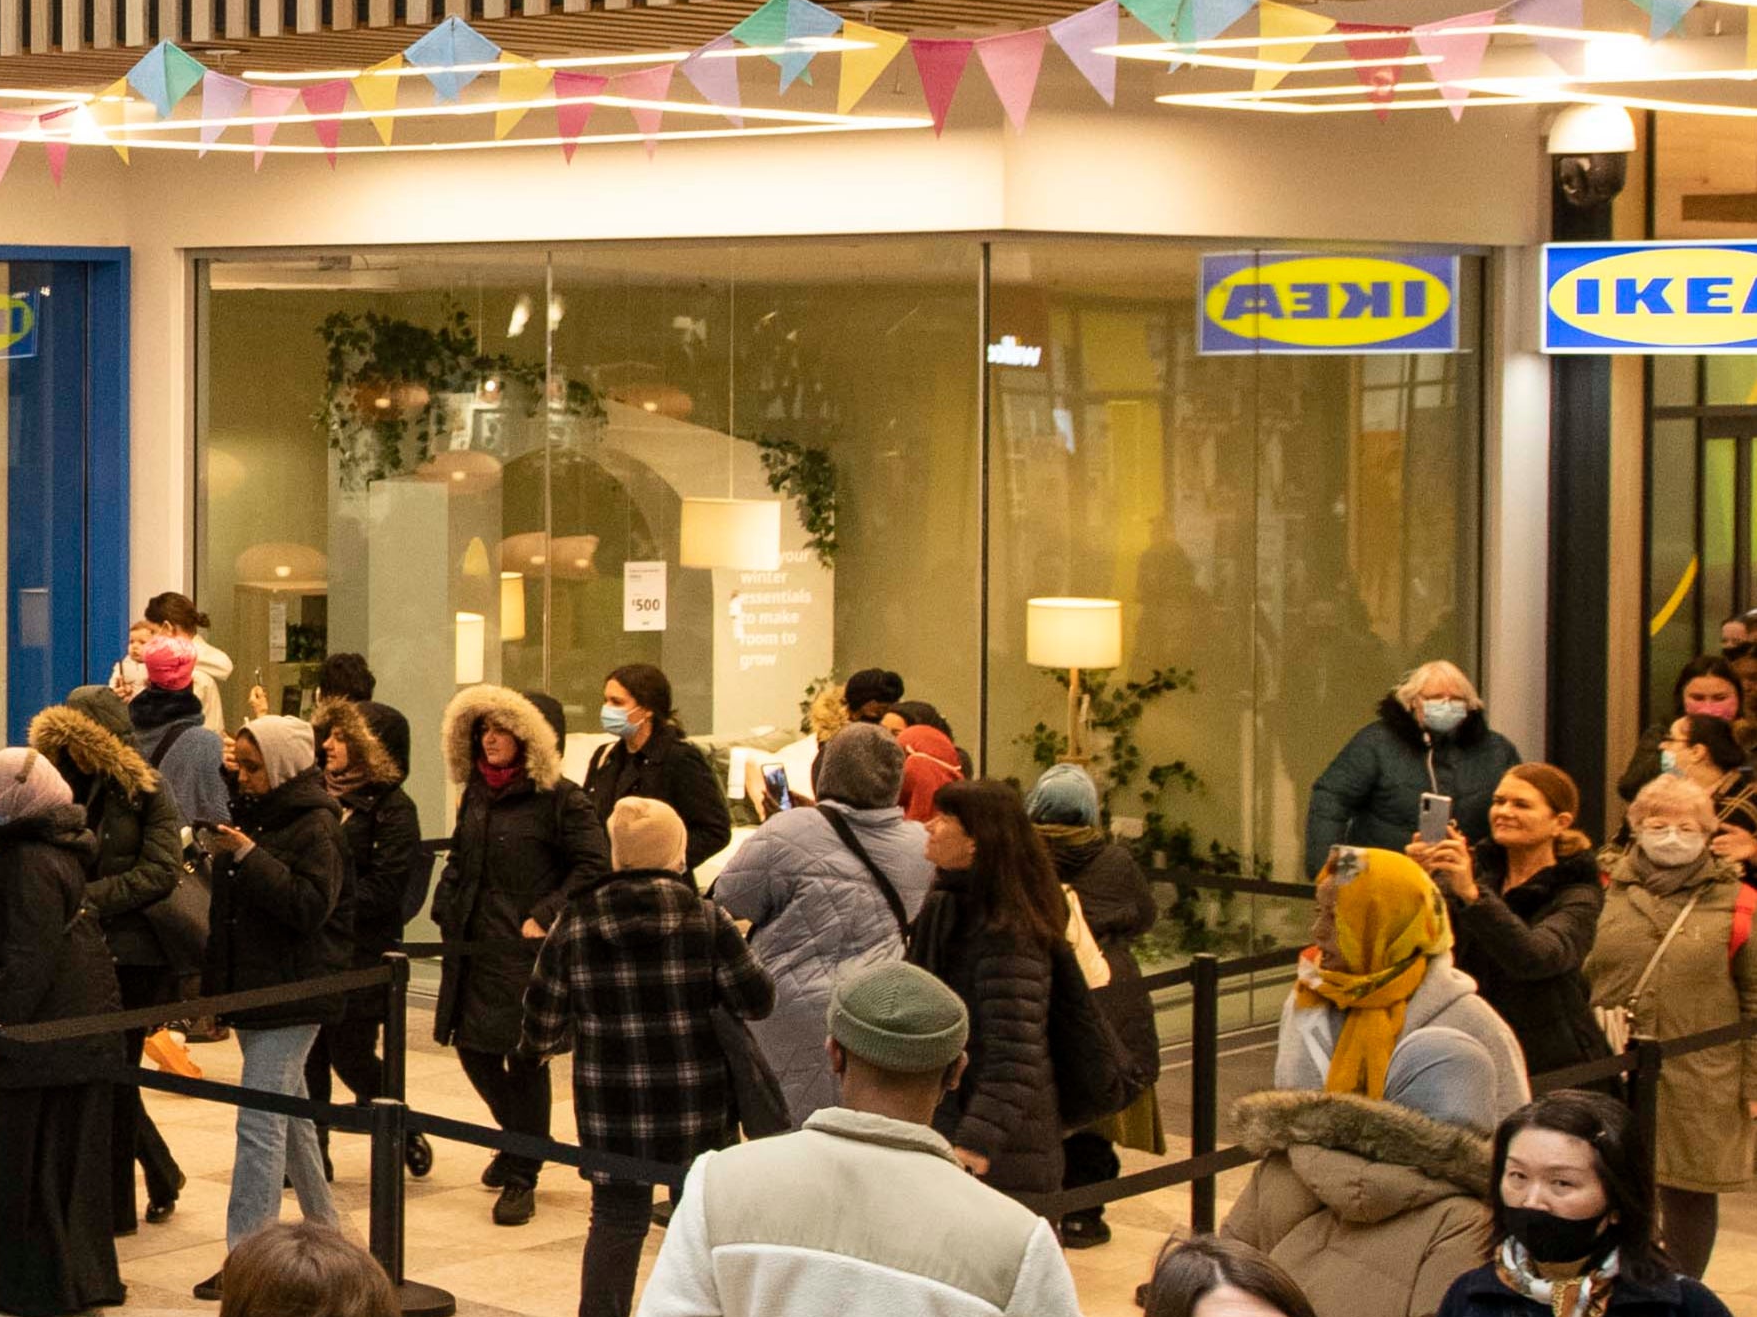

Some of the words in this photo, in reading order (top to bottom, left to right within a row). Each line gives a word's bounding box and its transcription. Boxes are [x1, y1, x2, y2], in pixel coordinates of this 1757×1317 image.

[740, 570, 789, 585] winter
[759, 609, 800, 624] make
[782, 631, 797, 646] to
[739, 652, 778, 671] grow
